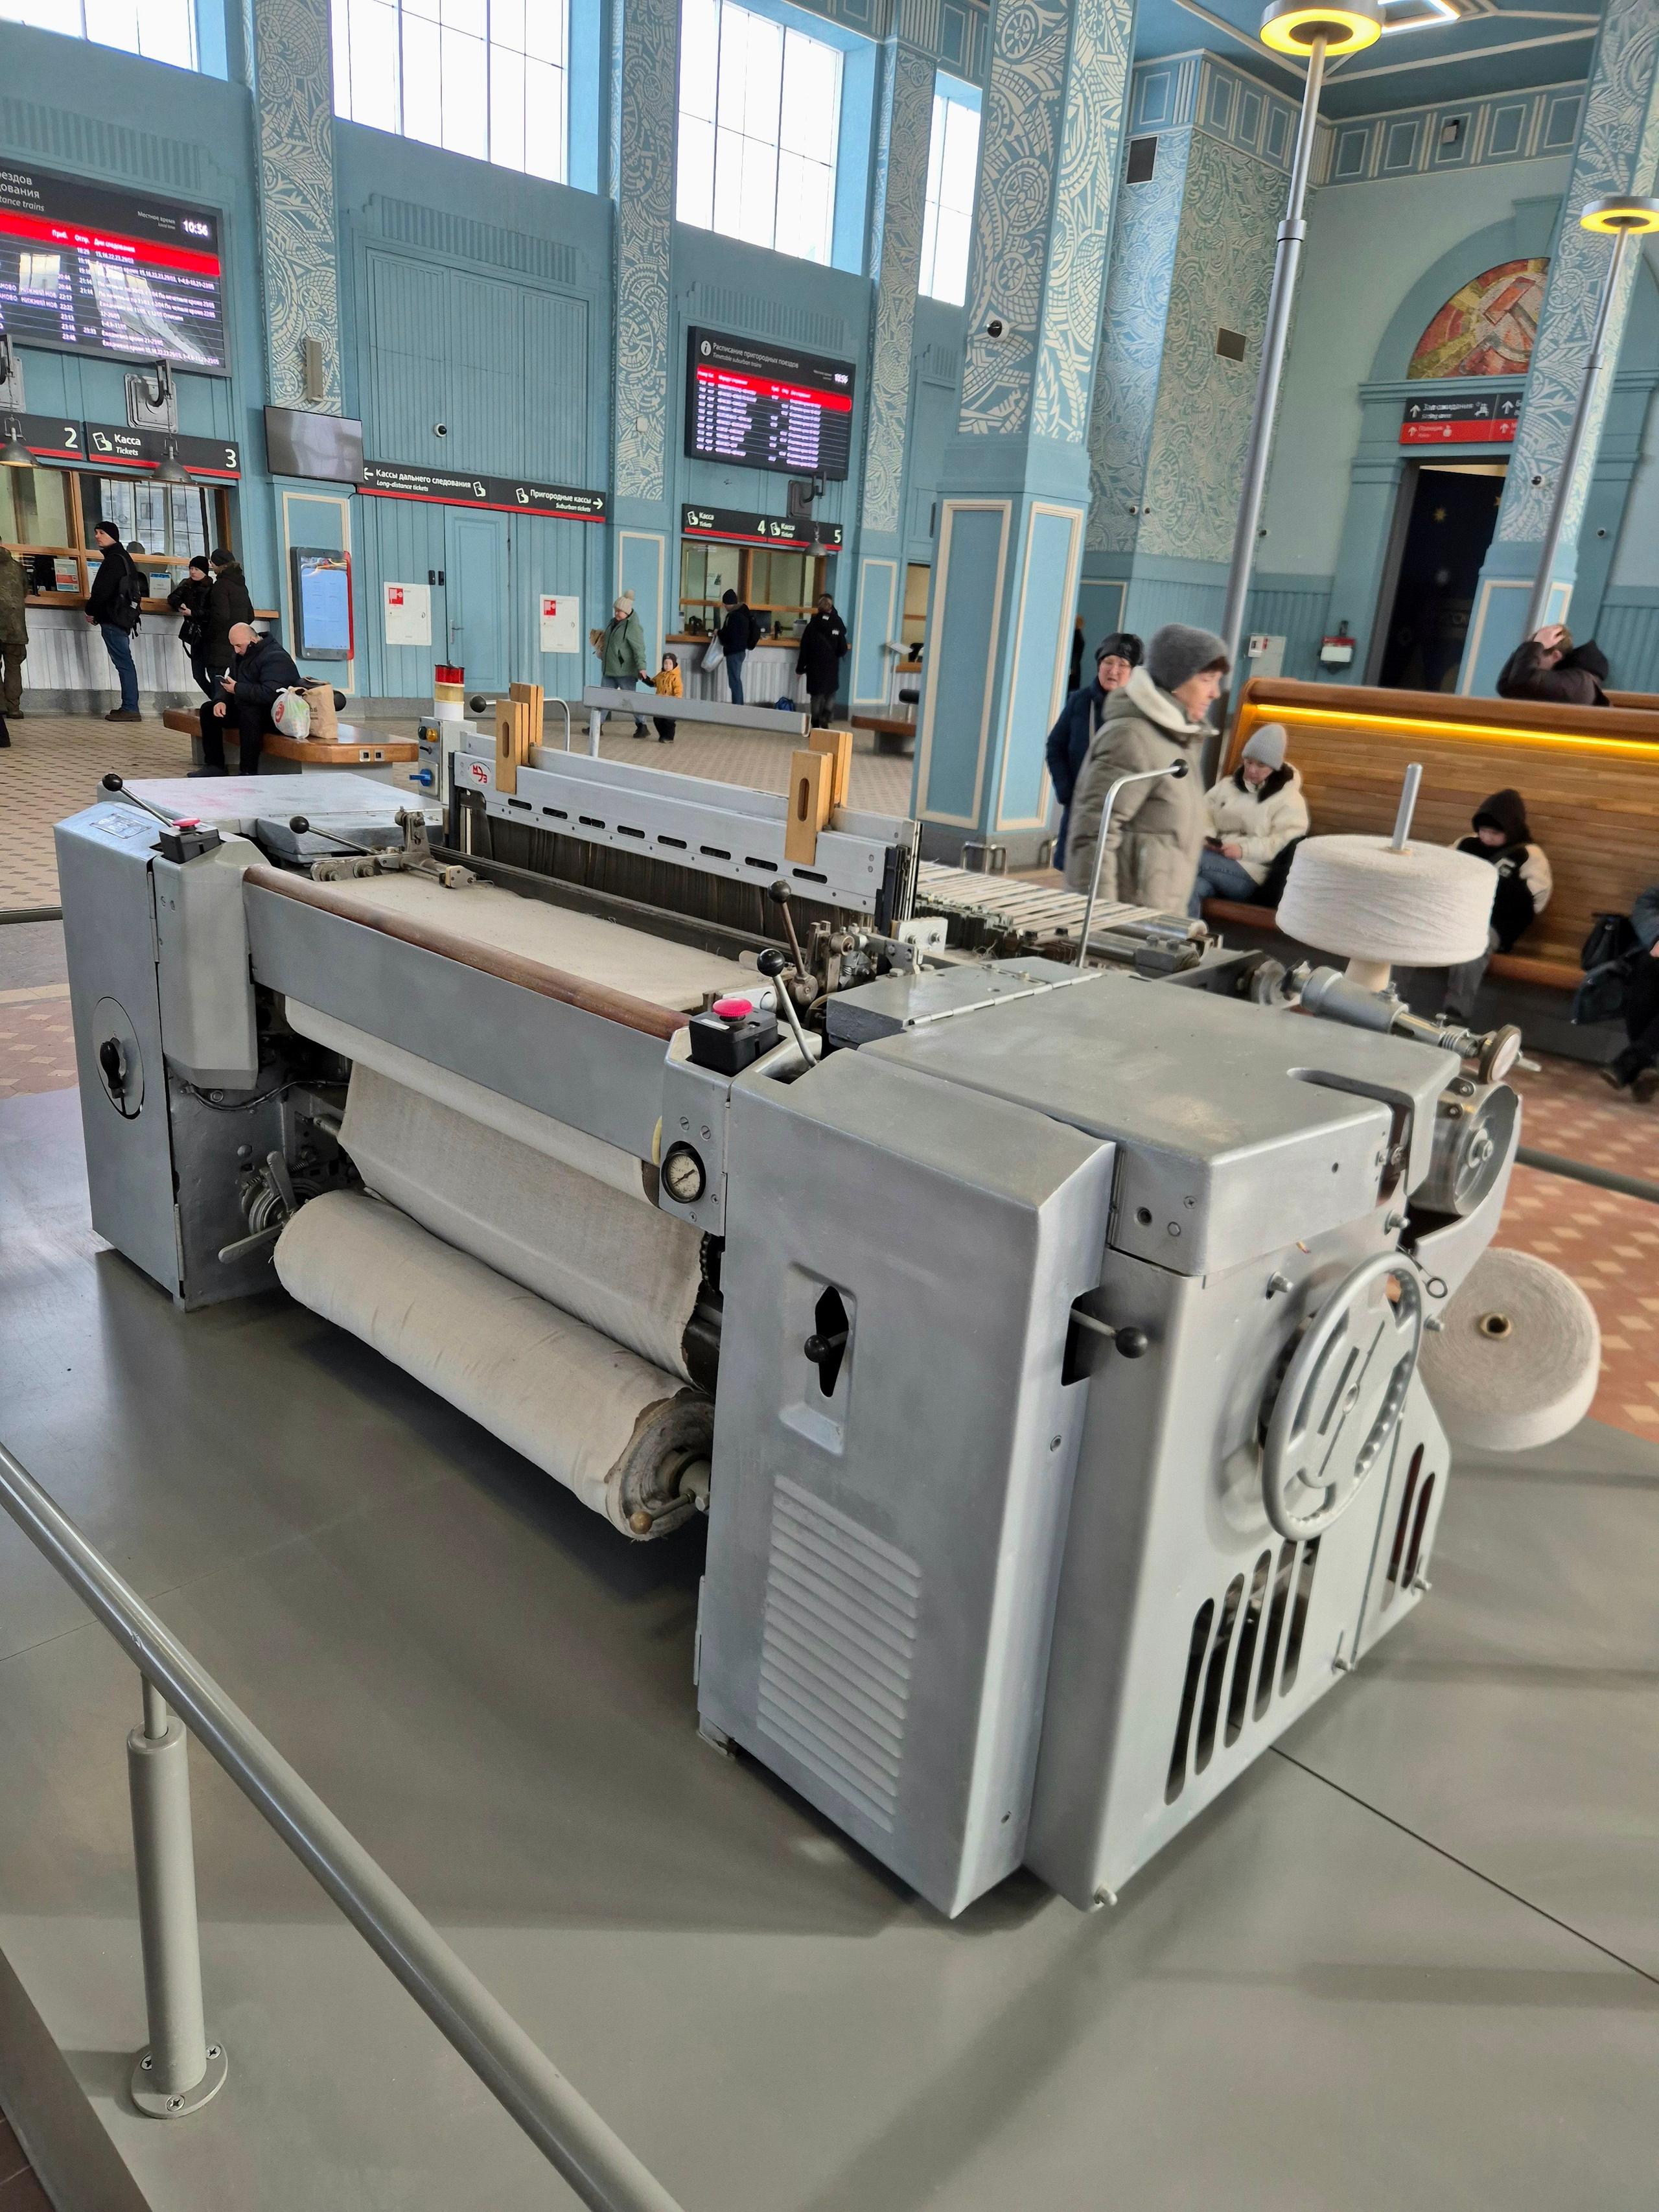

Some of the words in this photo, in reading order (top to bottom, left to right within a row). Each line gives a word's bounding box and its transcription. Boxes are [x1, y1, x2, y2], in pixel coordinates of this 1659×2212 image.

[0, 171, 32, 185] ездов
[0, 183, 40, 199] ования
[22, 200, 45, 212] trains
[137, 211, 159, 221] Местное
[159, 216, 176, 225] время
[183, 219, 208, 237] 10:56
[75, 234, 90, 244] Отпр.
[0, 283, 17, 292] НОВО
[58, 283, 72, 292] 20:44
[80, 287, 93, 296] 21:14
[713, 342, 743, 356] Расписание
[744, 351, 778, 364] пригородных
[778, 358, 799, 369] поездов
[713, 352, 732, 362] Timetable
[64, 427, 78, 448] 2
[114, 433, 141, 447] Касса
[115, 446, 139, 456] Tickets
[225, 448, 237, 468] 3
[376, 469, 398, 480] Кассы
[399, 473, 432, 484] дальнего
[432, 478, 471, 489] следования
[377, 480, 412, 490] Long-distance
[530, 489, 573, 502] Пригородные
[574, 496, 592, 504] кассы
[555, 502, 577, 511] Suburban
[699, 512, 714, 520] Касса
[757, 520, 766, 535] 4
[781, 523, 796, 531] Касса
[834, 530, 841, 544] 5
